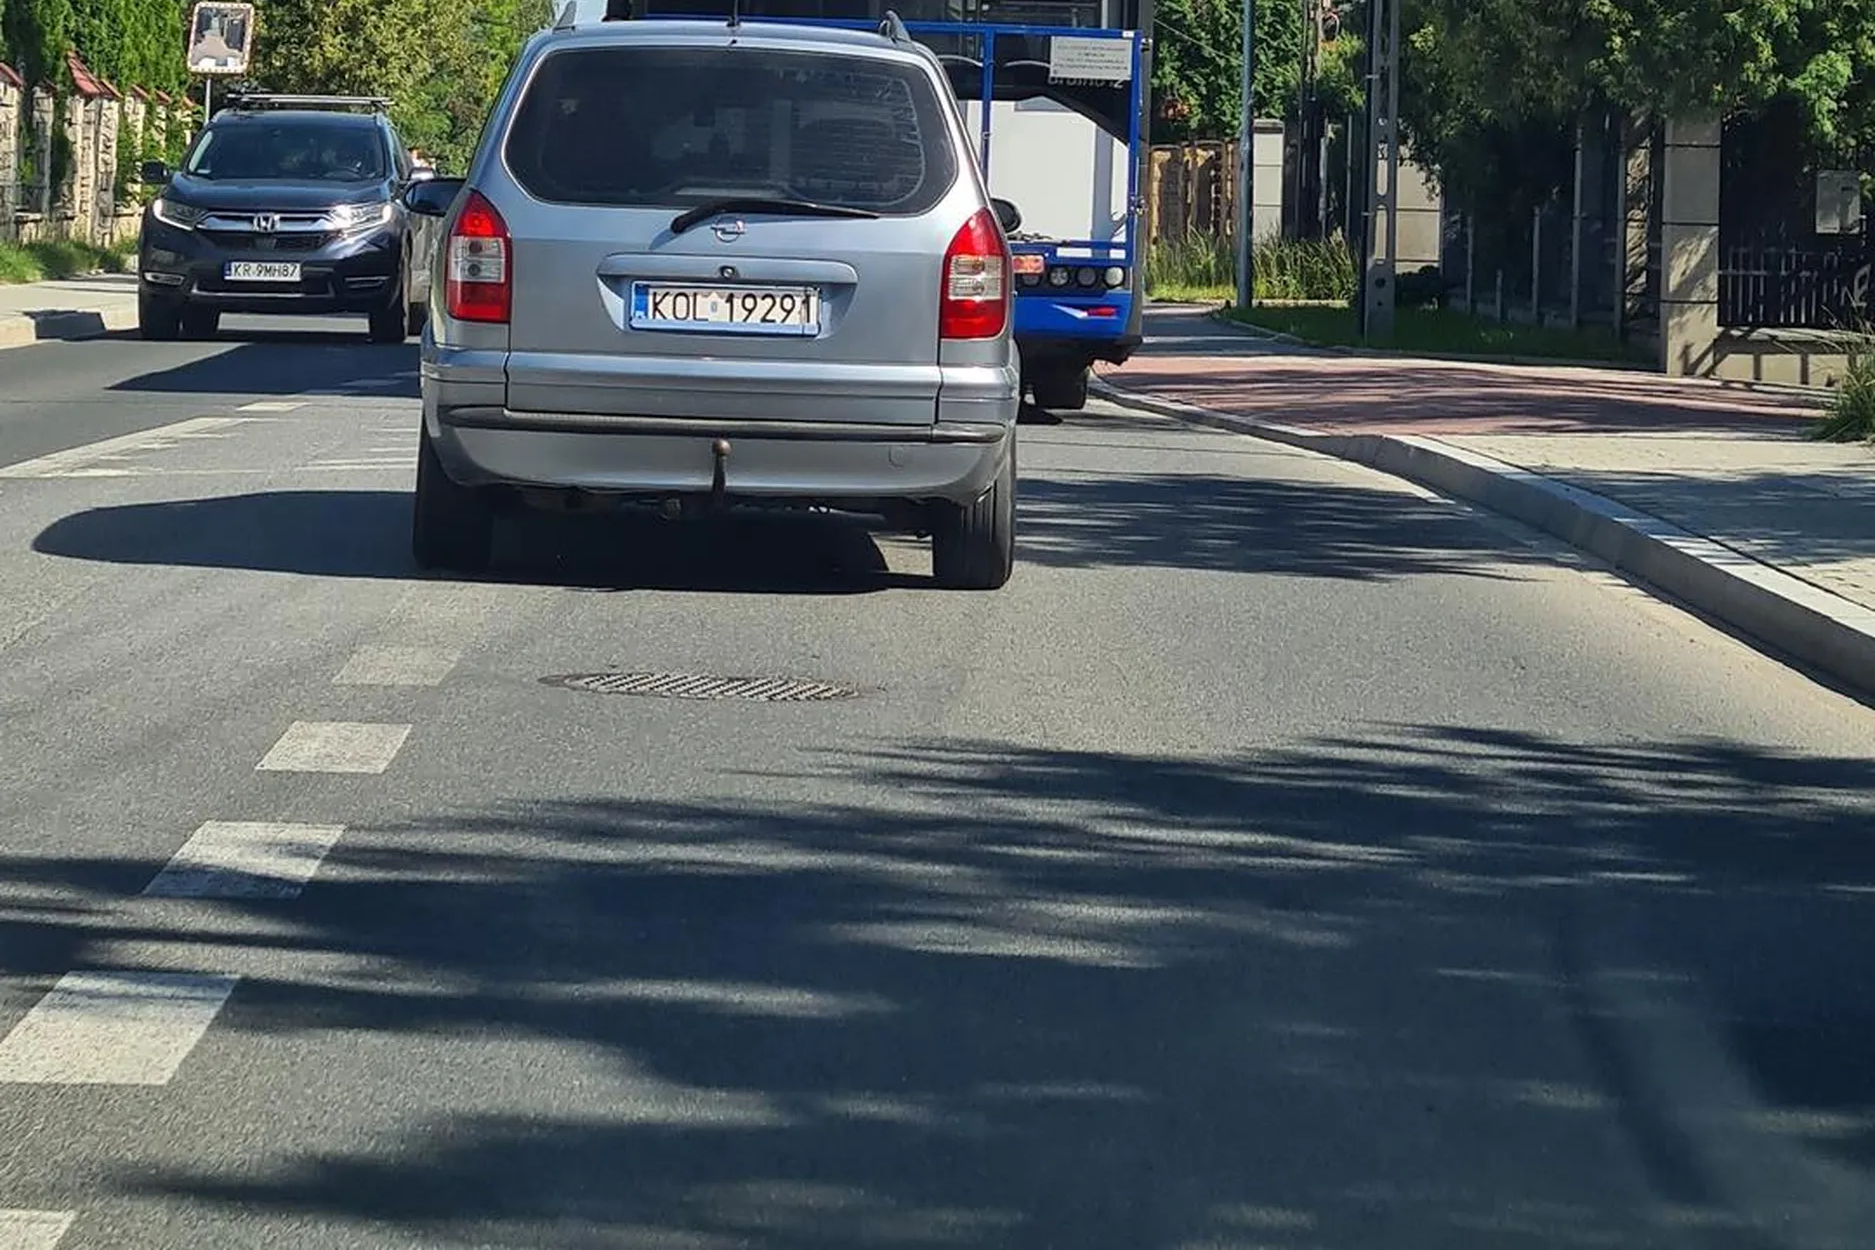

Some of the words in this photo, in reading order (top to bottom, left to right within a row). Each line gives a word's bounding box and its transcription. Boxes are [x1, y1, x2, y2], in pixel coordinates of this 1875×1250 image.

[233, 263, 252, 277] KR
[256, 263, 298, 277] 9MH87
[652, 291, 709, 322] KOL
[725, 292, 812, 324] 19291
